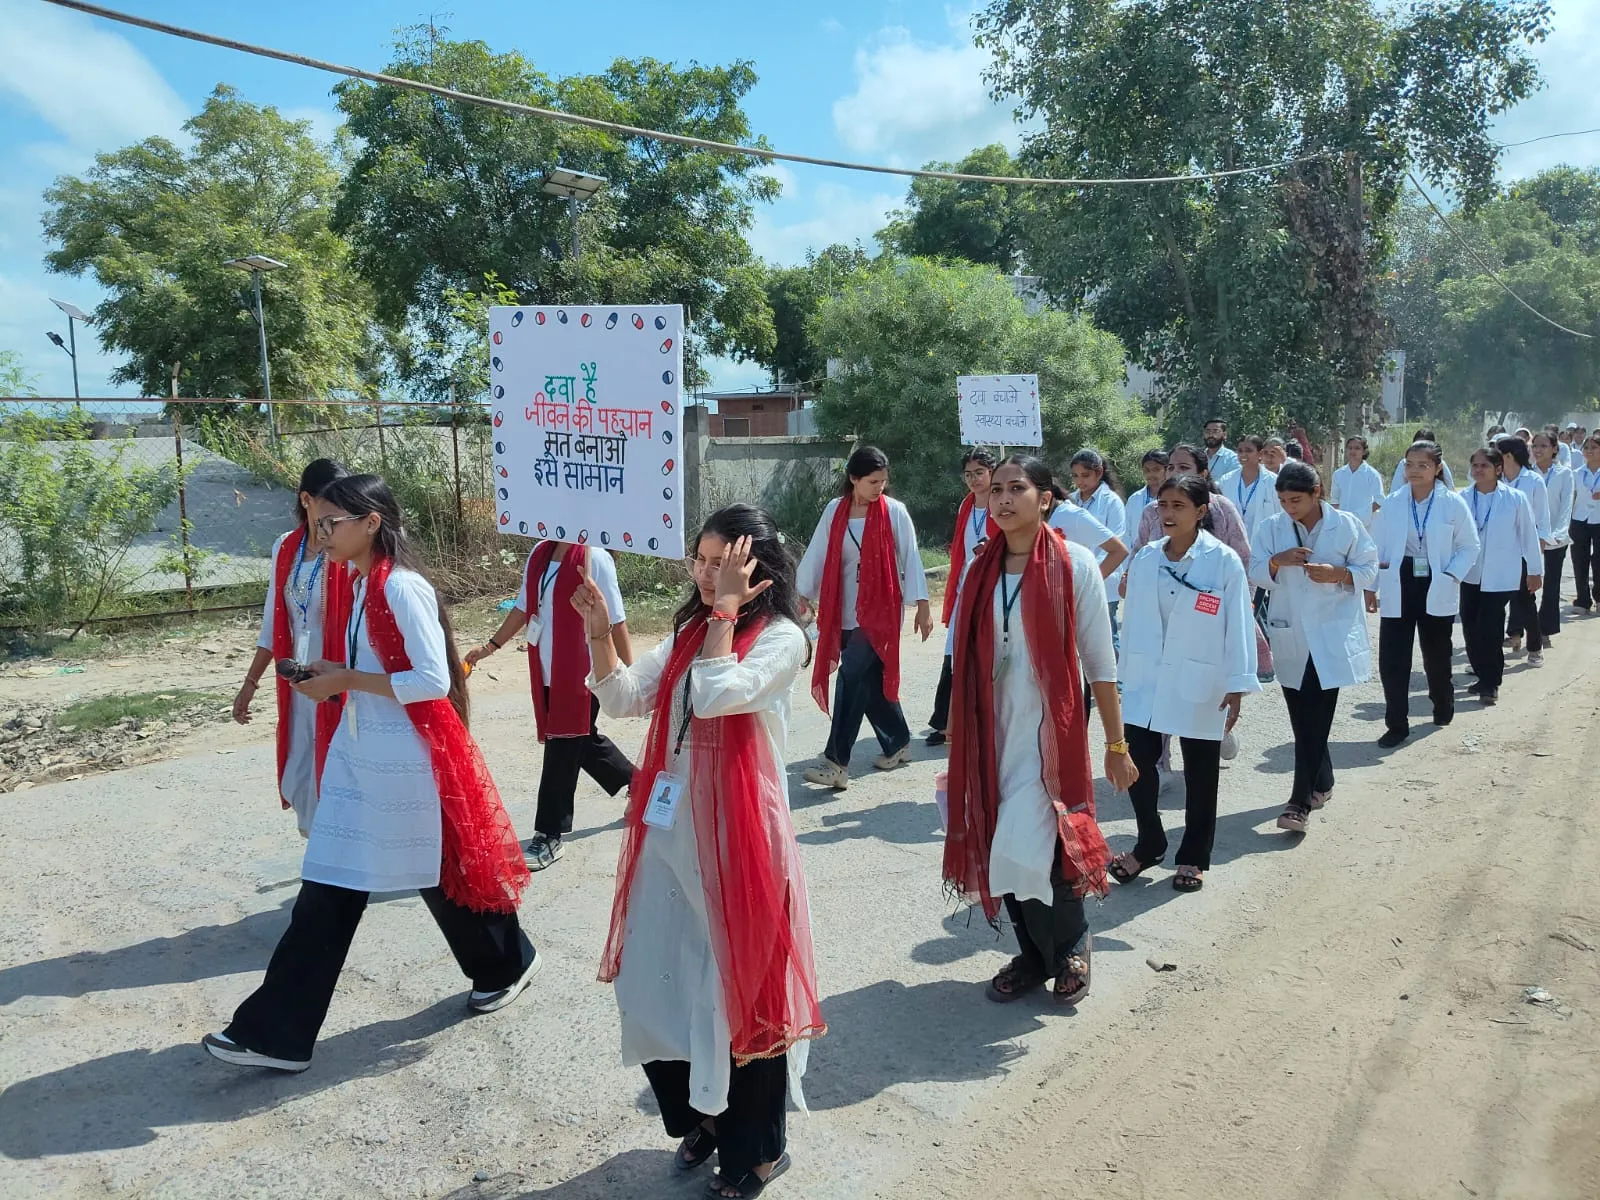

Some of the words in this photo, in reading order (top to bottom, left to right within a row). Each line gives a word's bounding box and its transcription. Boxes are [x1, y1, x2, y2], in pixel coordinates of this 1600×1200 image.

[544, 375, 576, 404] दवा
[580, 361, 598, 404] है
[525, 392, 570, 431] जीवन
[572, 398, 593, 433] की
[597, 408, 653, 439] पहचान
[544, 431, 572, 457] मत
[574, 430, 627, 464] बनाओ
[534, 451, 558, 487] इसे
[563, 461, 624, 494] सामान
